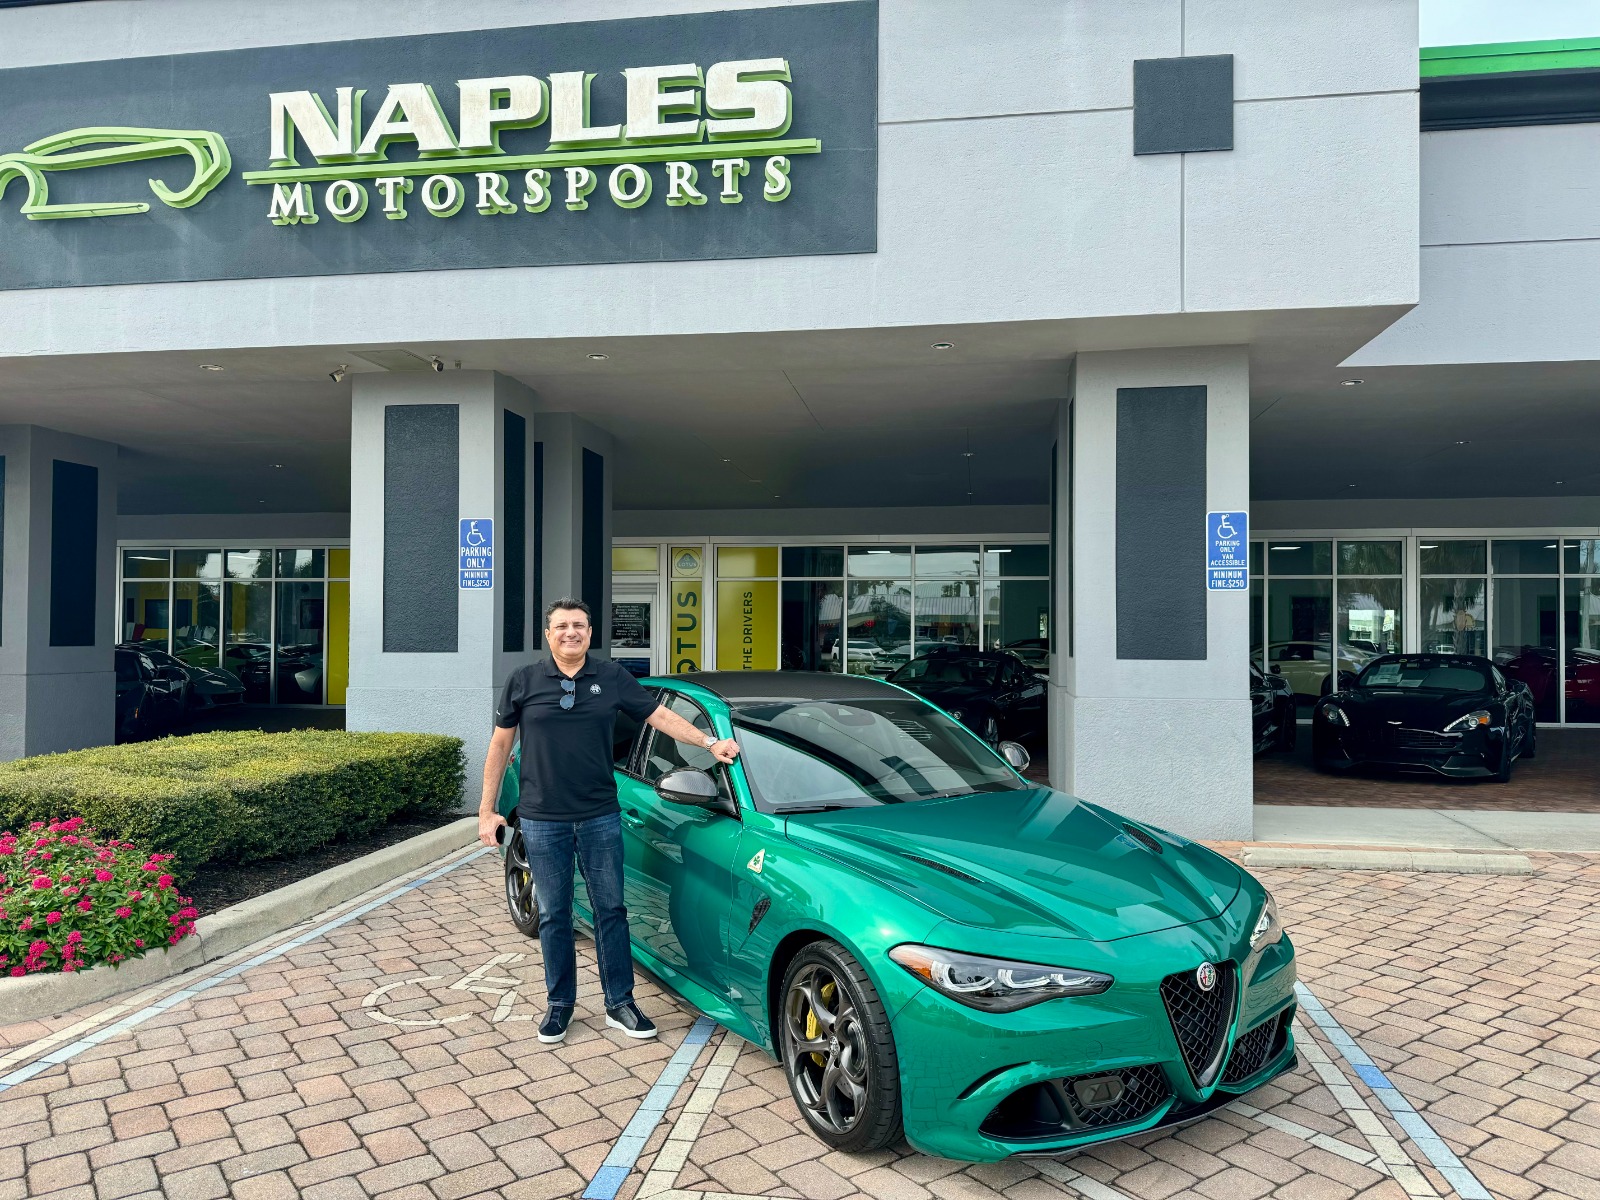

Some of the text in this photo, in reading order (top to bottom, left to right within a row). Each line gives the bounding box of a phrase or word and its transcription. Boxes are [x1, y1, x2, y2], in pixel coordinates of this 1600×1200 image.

[269, 57, 792, 167] NAPLES
[268, 155, 792, 226] MOTORSPORTS
[461, 547, 492, 556] PARKING
[466, 558, 486, 568] ONLY
[1228, 579, 1244, 588] $250
[742, 591, 753, 670] THE DRIVERS
